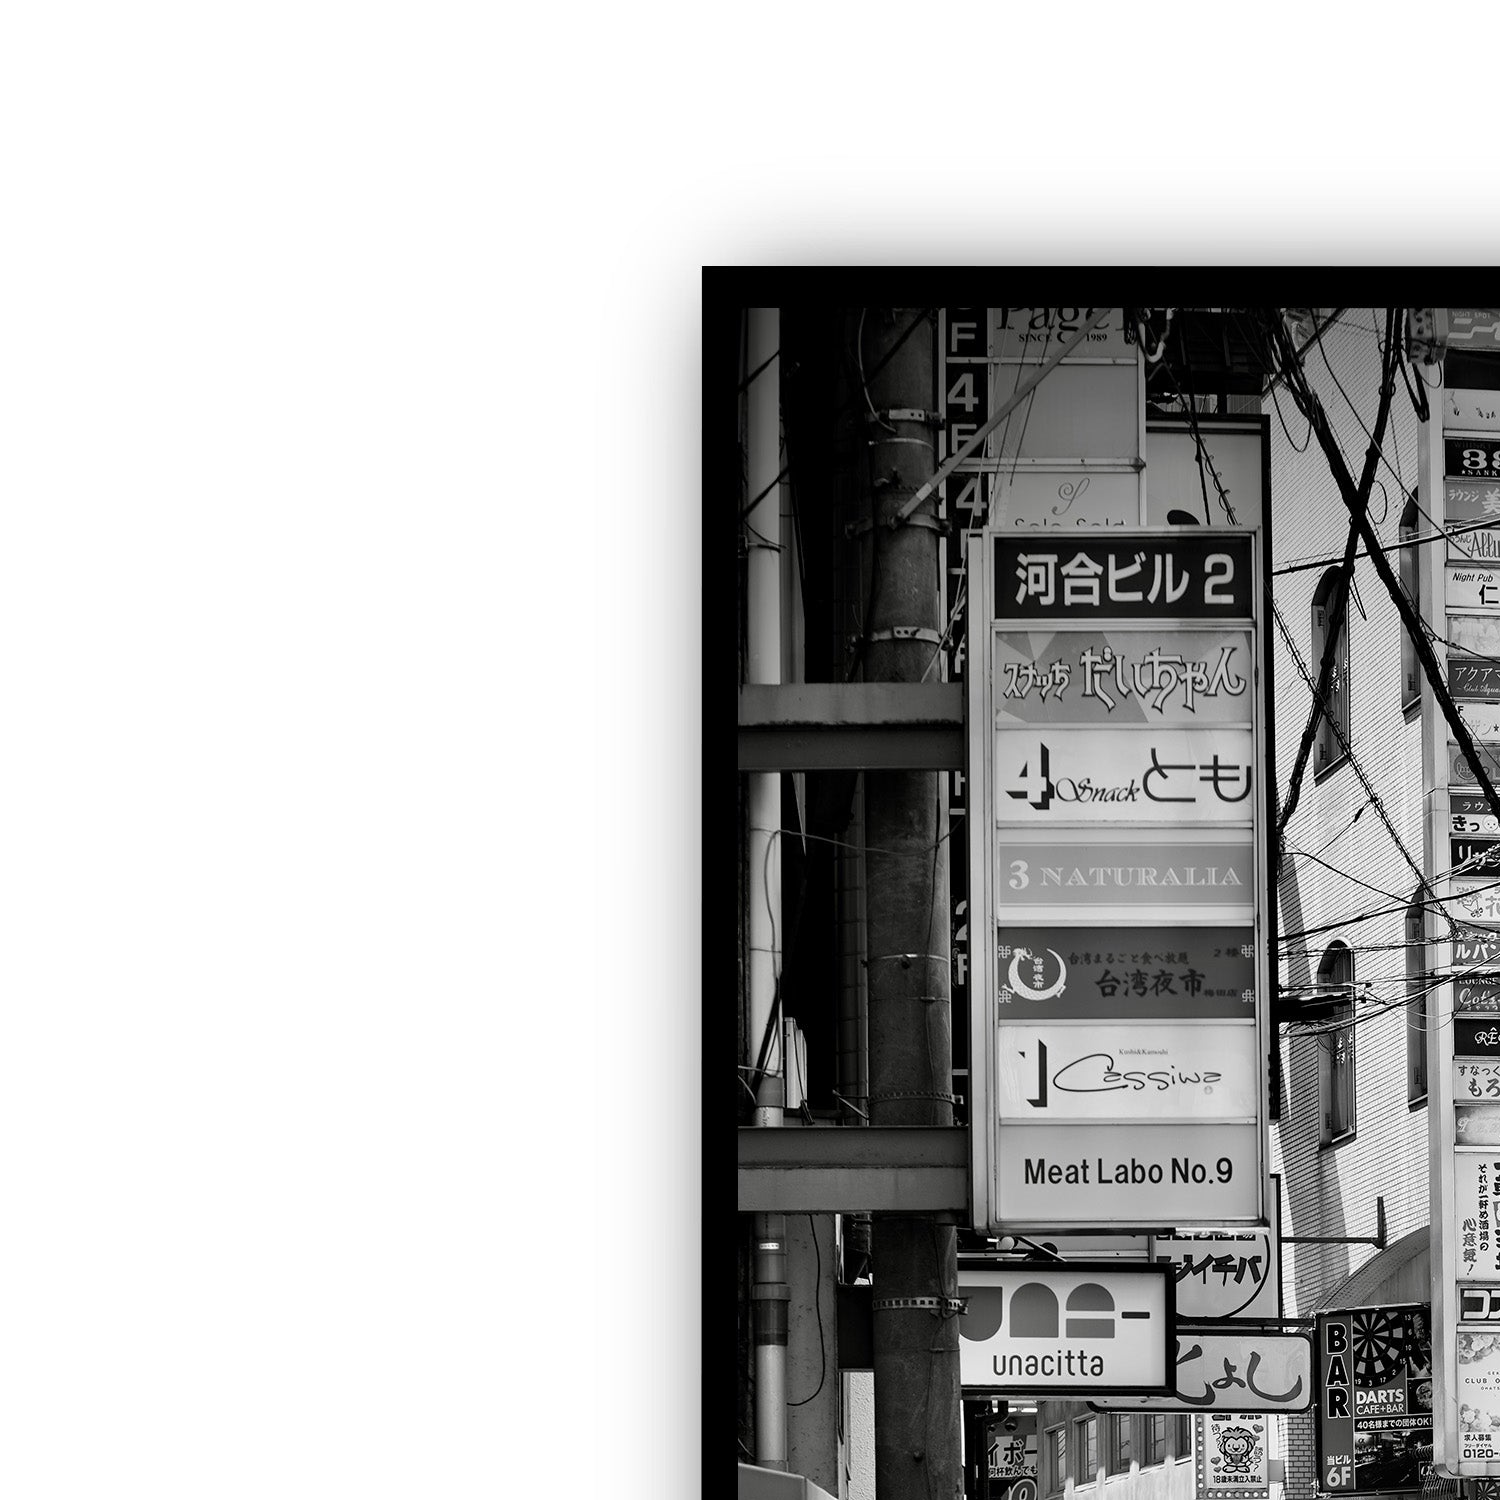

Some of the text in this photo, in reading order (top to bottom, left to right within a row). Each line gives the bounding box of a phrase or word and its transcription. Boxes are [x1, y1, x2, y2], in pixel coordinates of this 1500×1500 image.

[1087, 333, 1107, 342] 1989
[1449, 490, 1479, 501] ラウンジ
[1016, 552, 1234, 605] 河合ビル 2
[1453, 573, 1494, 584] Night Pub
[1479, 584, 1499, 605] 仁
[1081, 646, 1247, 712] だいちゃん
[1005, 742, 1251, 809] 4 Snack とも
[1008, 860, 1242, 888] 3 NATURALIA
[1095, 968, 1205, 997] 台湾夜市
[1458, 1066, 1500, 1075] すなっく
[1025, 1158, 1233, 1184] Meat Labo No.9
[1478, 1163, 1490, 1251] それが一軒め酒場の
[992, 1349, 1104, 1377] unacitta
[1326, 1323, 1351, 1419] BAR
[1356, 1389, 1405, 1405] DARTS
[1356, 1404, 1405, 1415] CAFE+BAR
[1326, 1466, 1351, 1487] 6F
